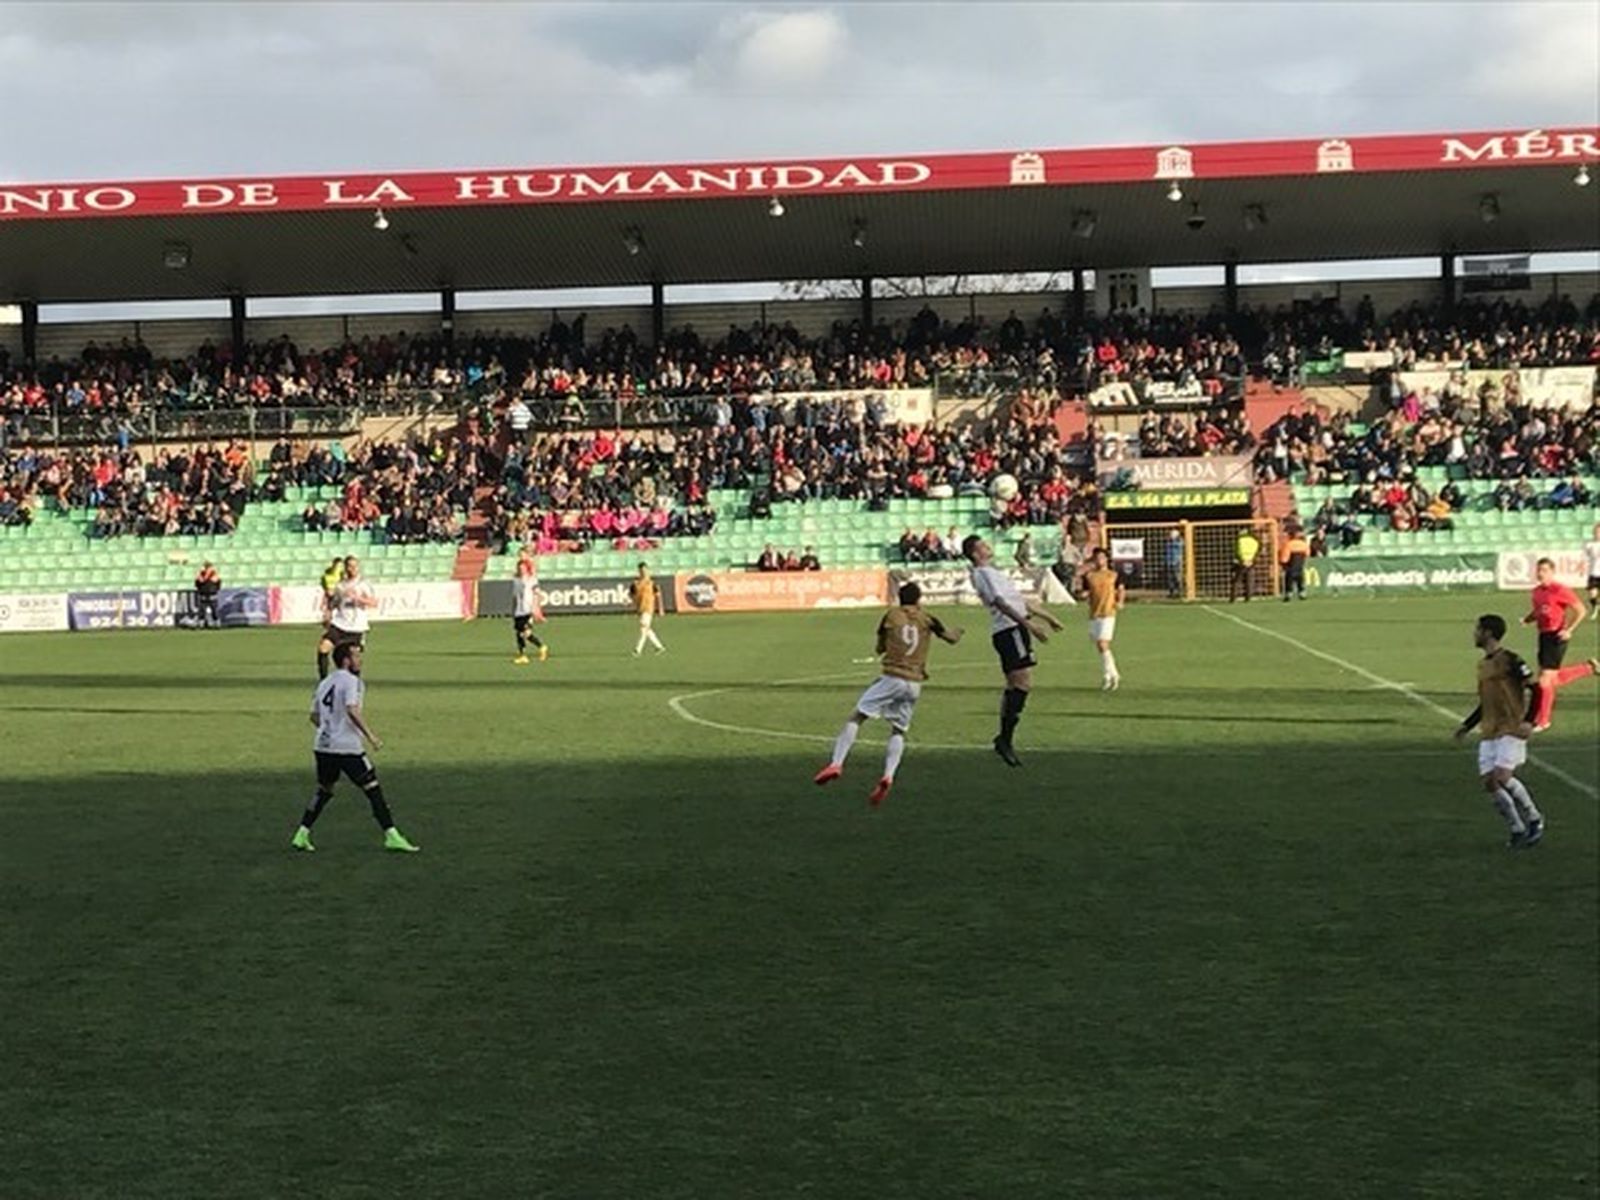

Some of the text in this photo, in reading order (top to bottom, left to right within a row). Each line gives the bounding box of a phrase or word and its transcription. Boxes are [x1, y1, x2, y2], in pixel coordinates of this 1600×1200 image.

[1439, 129, 1600, 162] MÉR
[0, 161, 931, 213] NIO DE LA HUMANIDAD
[901, 623, 919, 656] 9
[322, 684, 336, 714] 4
